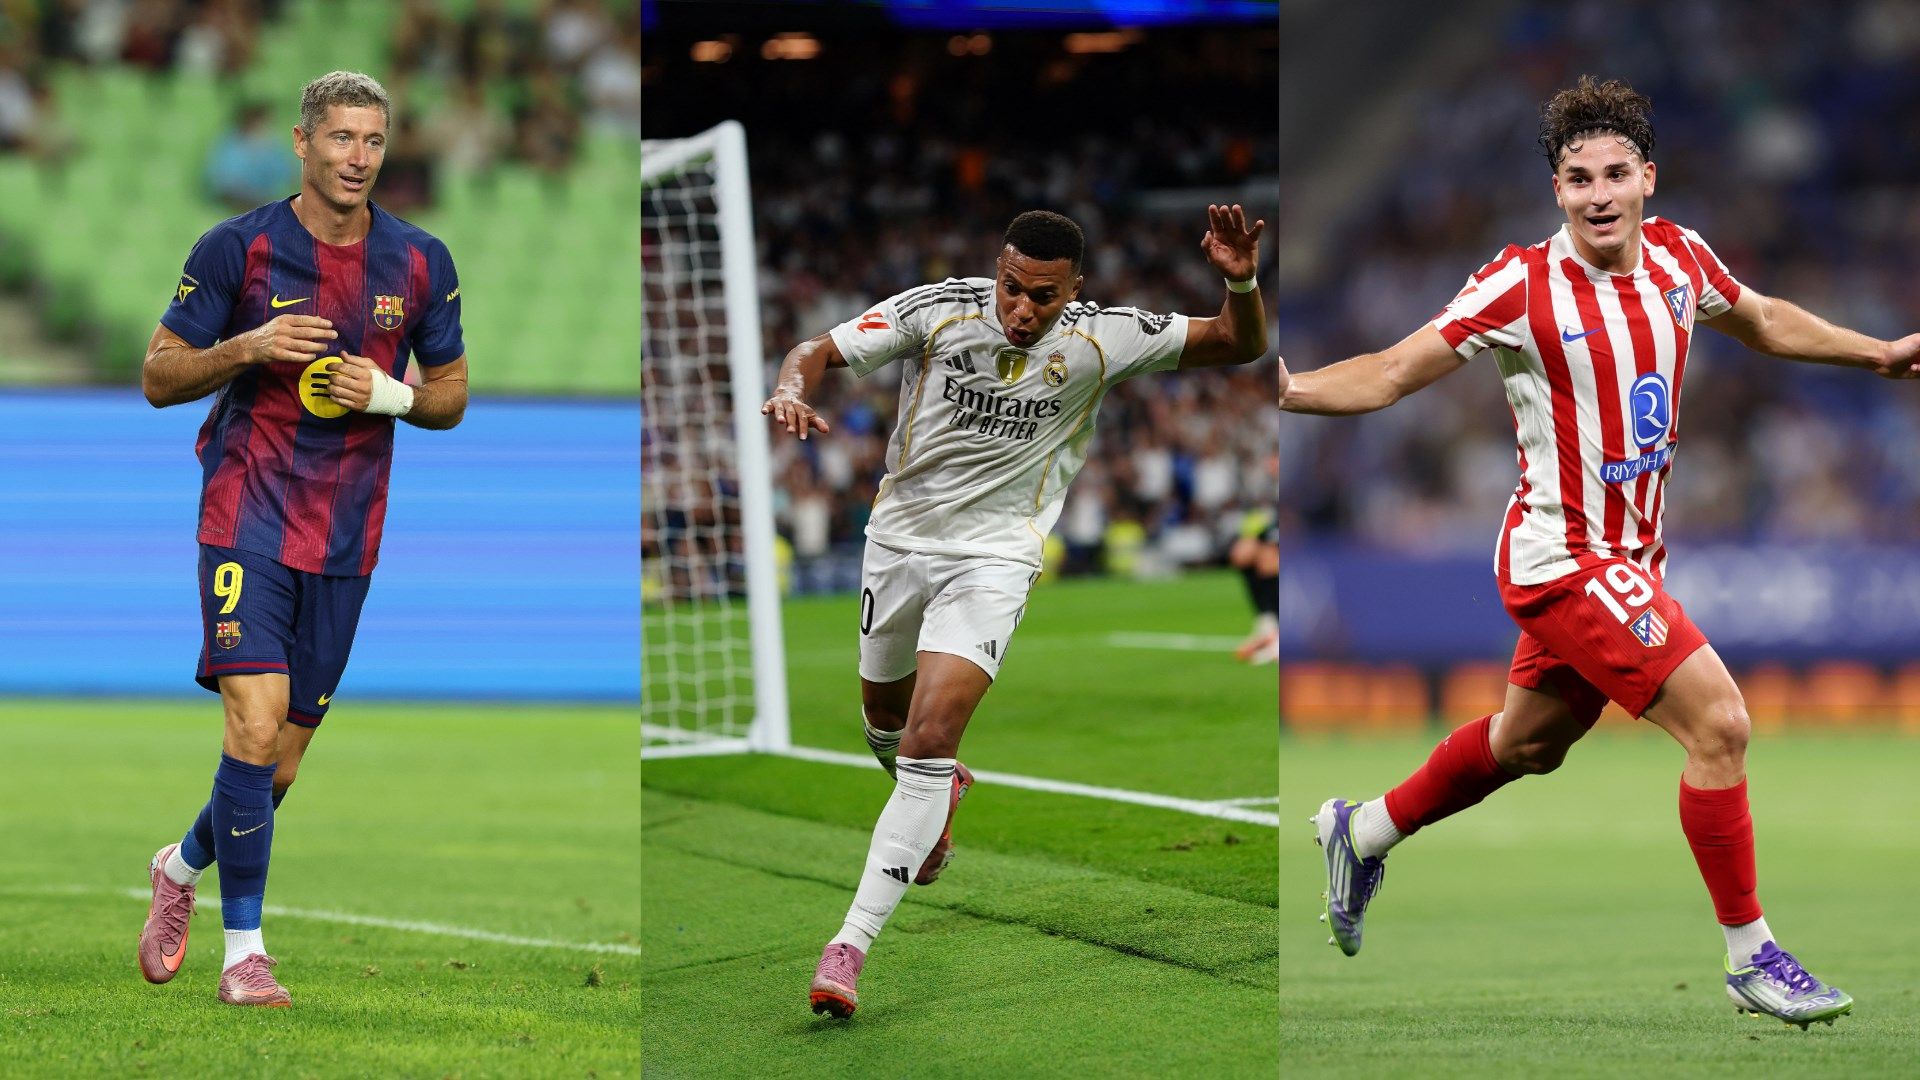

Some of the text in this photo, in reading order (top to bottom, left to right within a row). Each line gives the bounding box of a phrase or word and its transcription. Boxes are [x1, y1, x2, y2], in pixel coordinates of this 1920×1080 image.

[943, 376, 1061, 419] Emirates
[949, 407, 1038, 440] FLY BETTER
[1605, 454, 1659, 480] RIYADH
[214, 562, 244, 614] 9
[1584, 564, 1654, 625] 19
